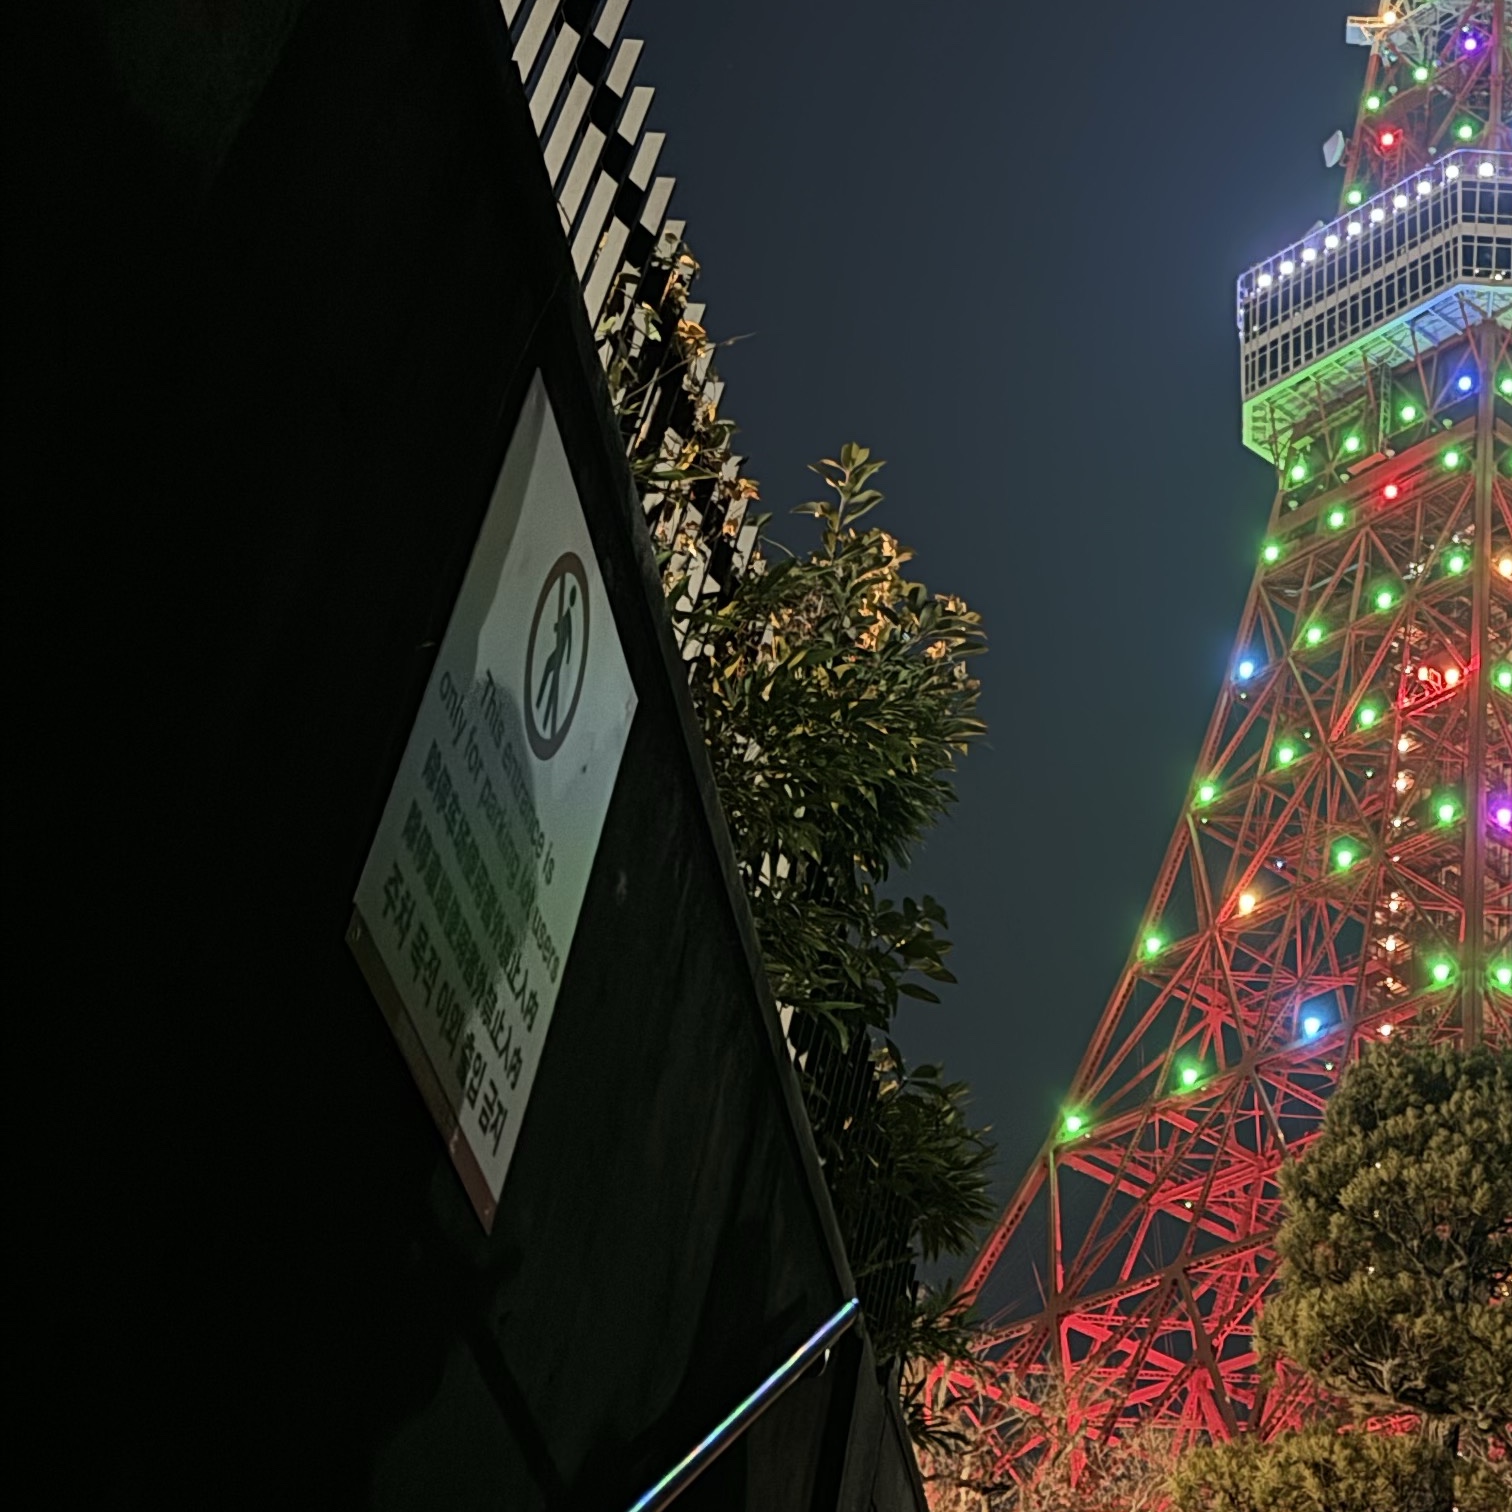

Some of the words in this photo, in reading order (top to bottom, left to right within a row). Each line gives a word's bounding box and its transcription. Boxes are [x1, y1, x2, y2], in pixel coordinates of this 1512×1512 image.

[439, 671, 467, 746] only
[464, 725, 483, 782] for
[477, 775, 519, 889] parking
[518, 864, 535, 922] lot
[532, 907, 559, 983] users
[480, 669, 504, 748] This
[502, 742, 544, 858] entrance
[542, 842, 554, 885] is
[382, 861, 415, 949] 주차
[410, 922, 441, 1007] 목적
[436, 981, 465, 1058] 이외
[457, 1033, 486, 1109] 출입
[478, 1079, 507, 1156] 금지
